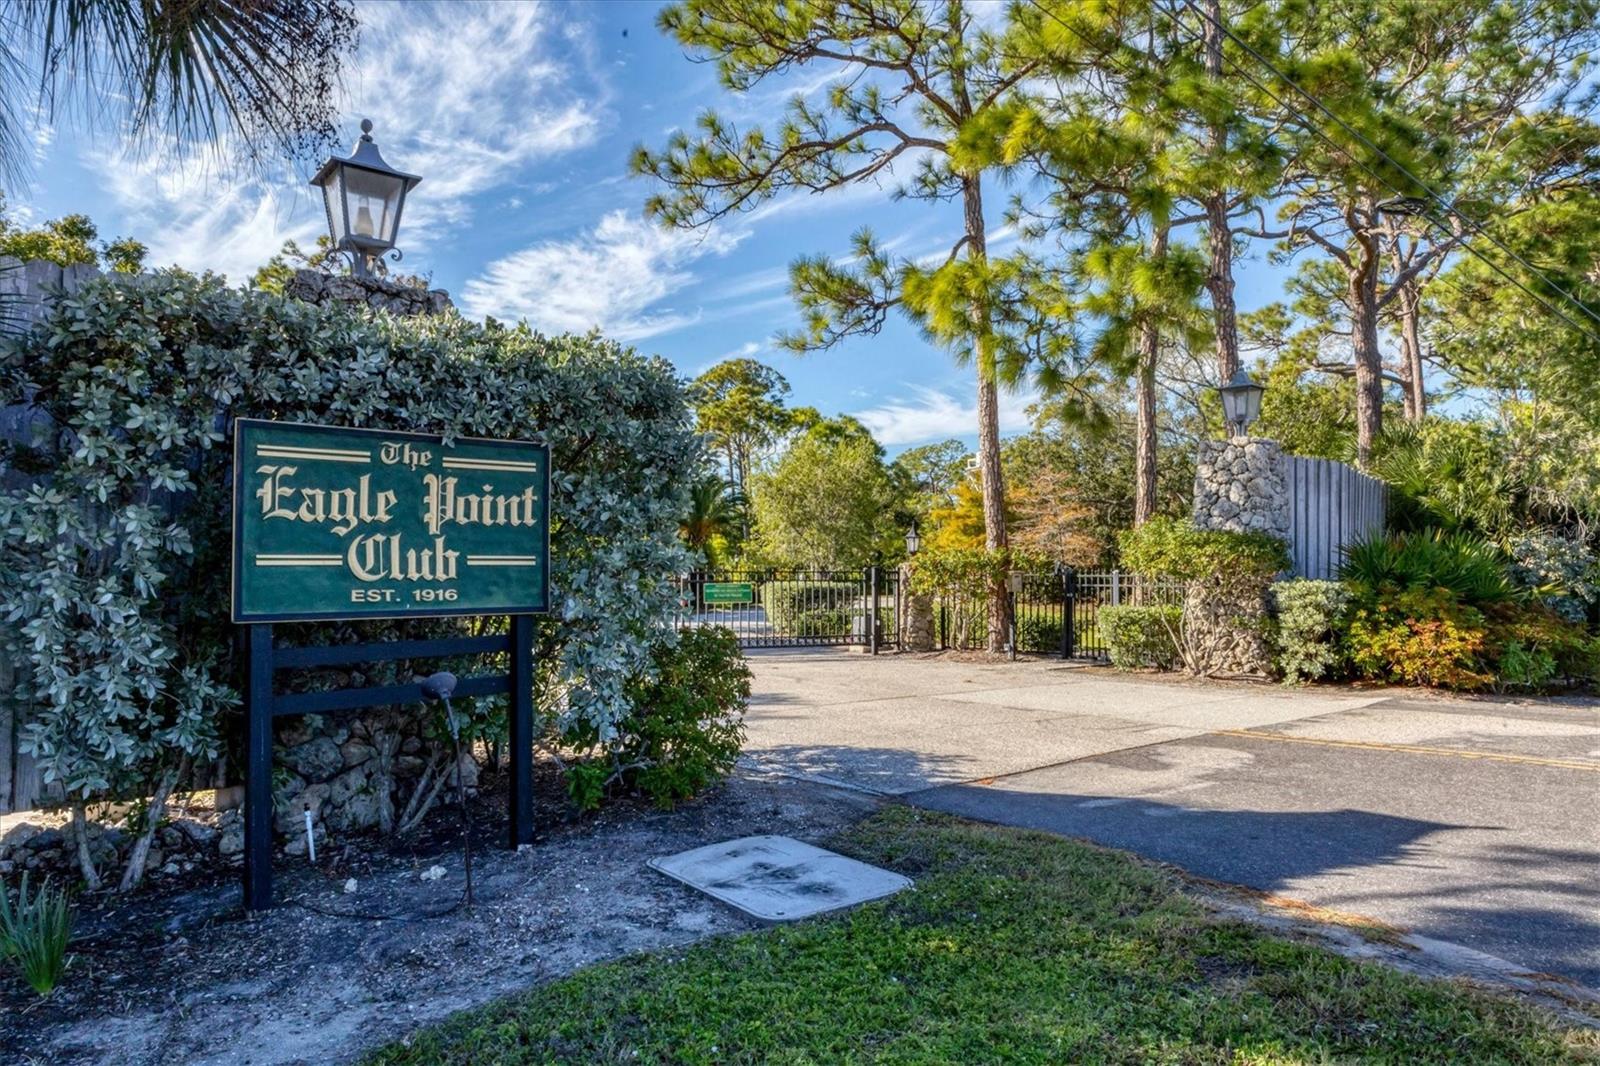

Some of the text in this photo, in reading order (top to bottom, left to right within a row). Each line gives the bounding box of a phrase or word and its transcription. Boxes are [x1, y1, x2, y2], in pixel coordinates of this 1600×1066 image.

[380, 441, 432, 471] The
[256, 464, 538, 536] Eagle Point
[347, 532, 460, 582] Club
[351, 588, 458, 602] EST. 1916
